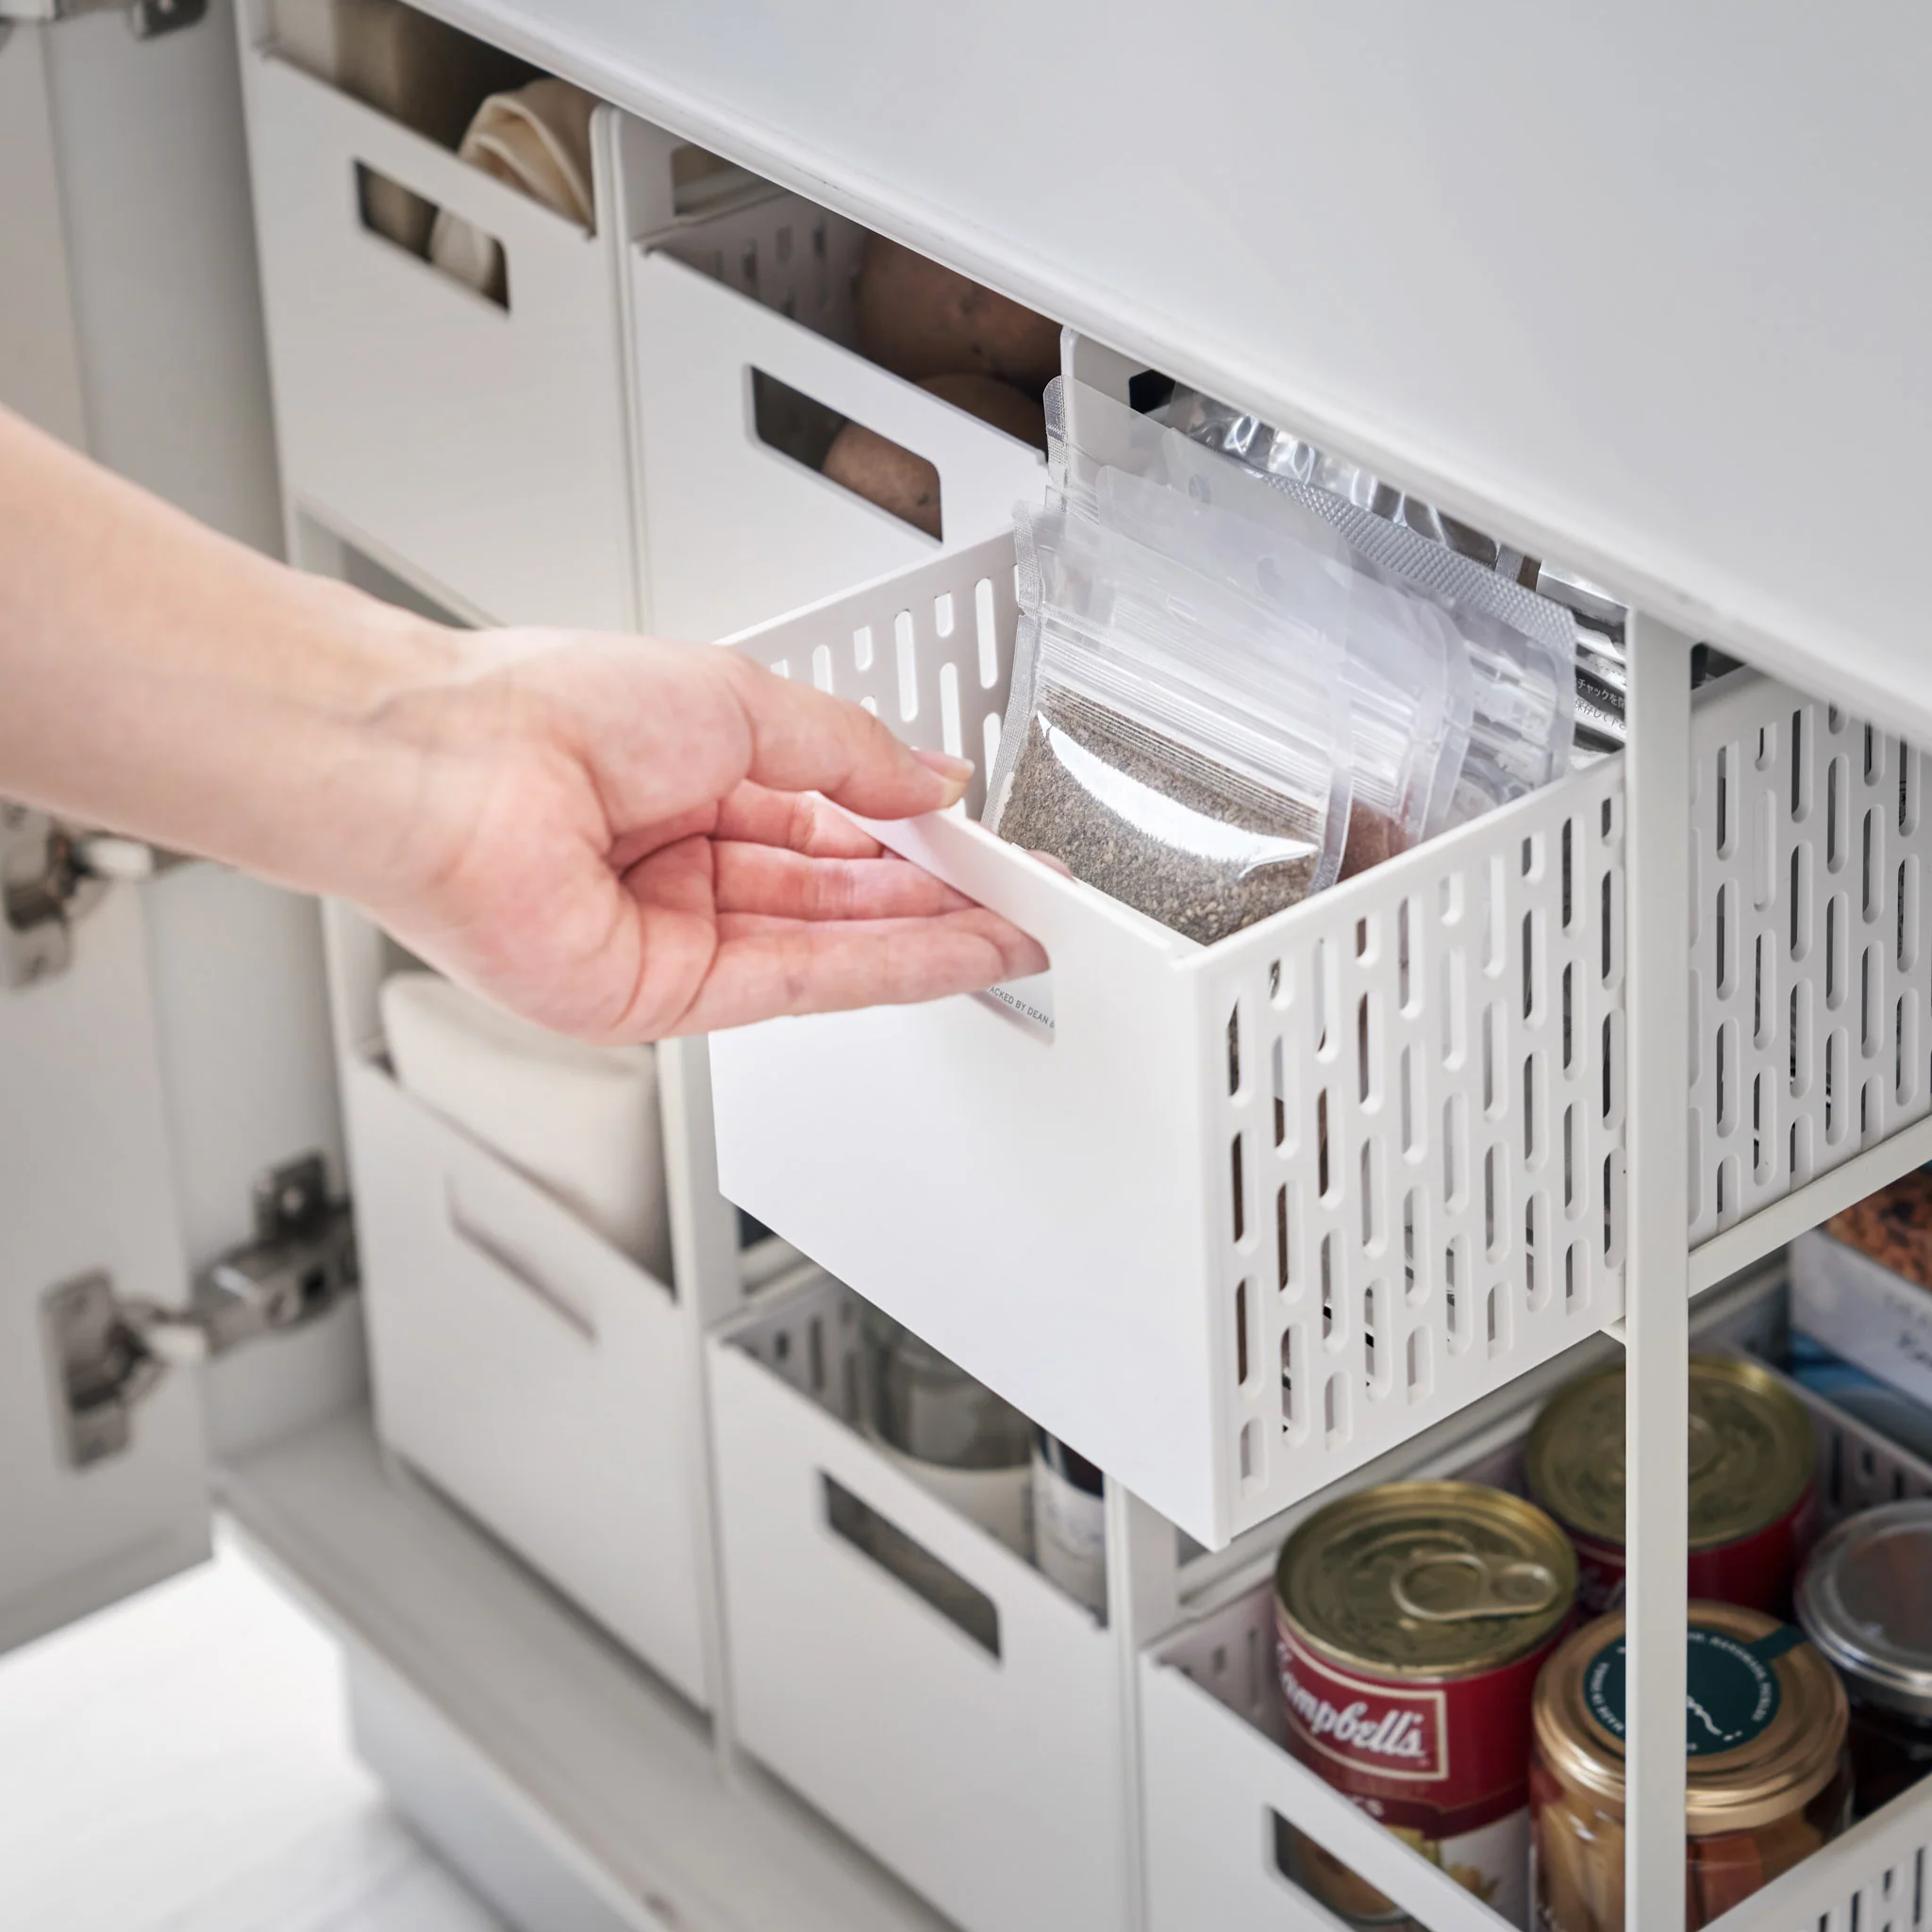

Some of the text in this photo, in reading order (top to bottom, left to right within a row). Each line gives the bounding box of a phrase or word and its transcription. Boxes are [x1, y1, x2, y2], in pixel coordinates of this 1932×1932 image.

[989, 986, 1014, 1005] ACKED
[1015, 1000, 1026, 1011] BY
[1026, 1007, 1049, 1024] DEAN
